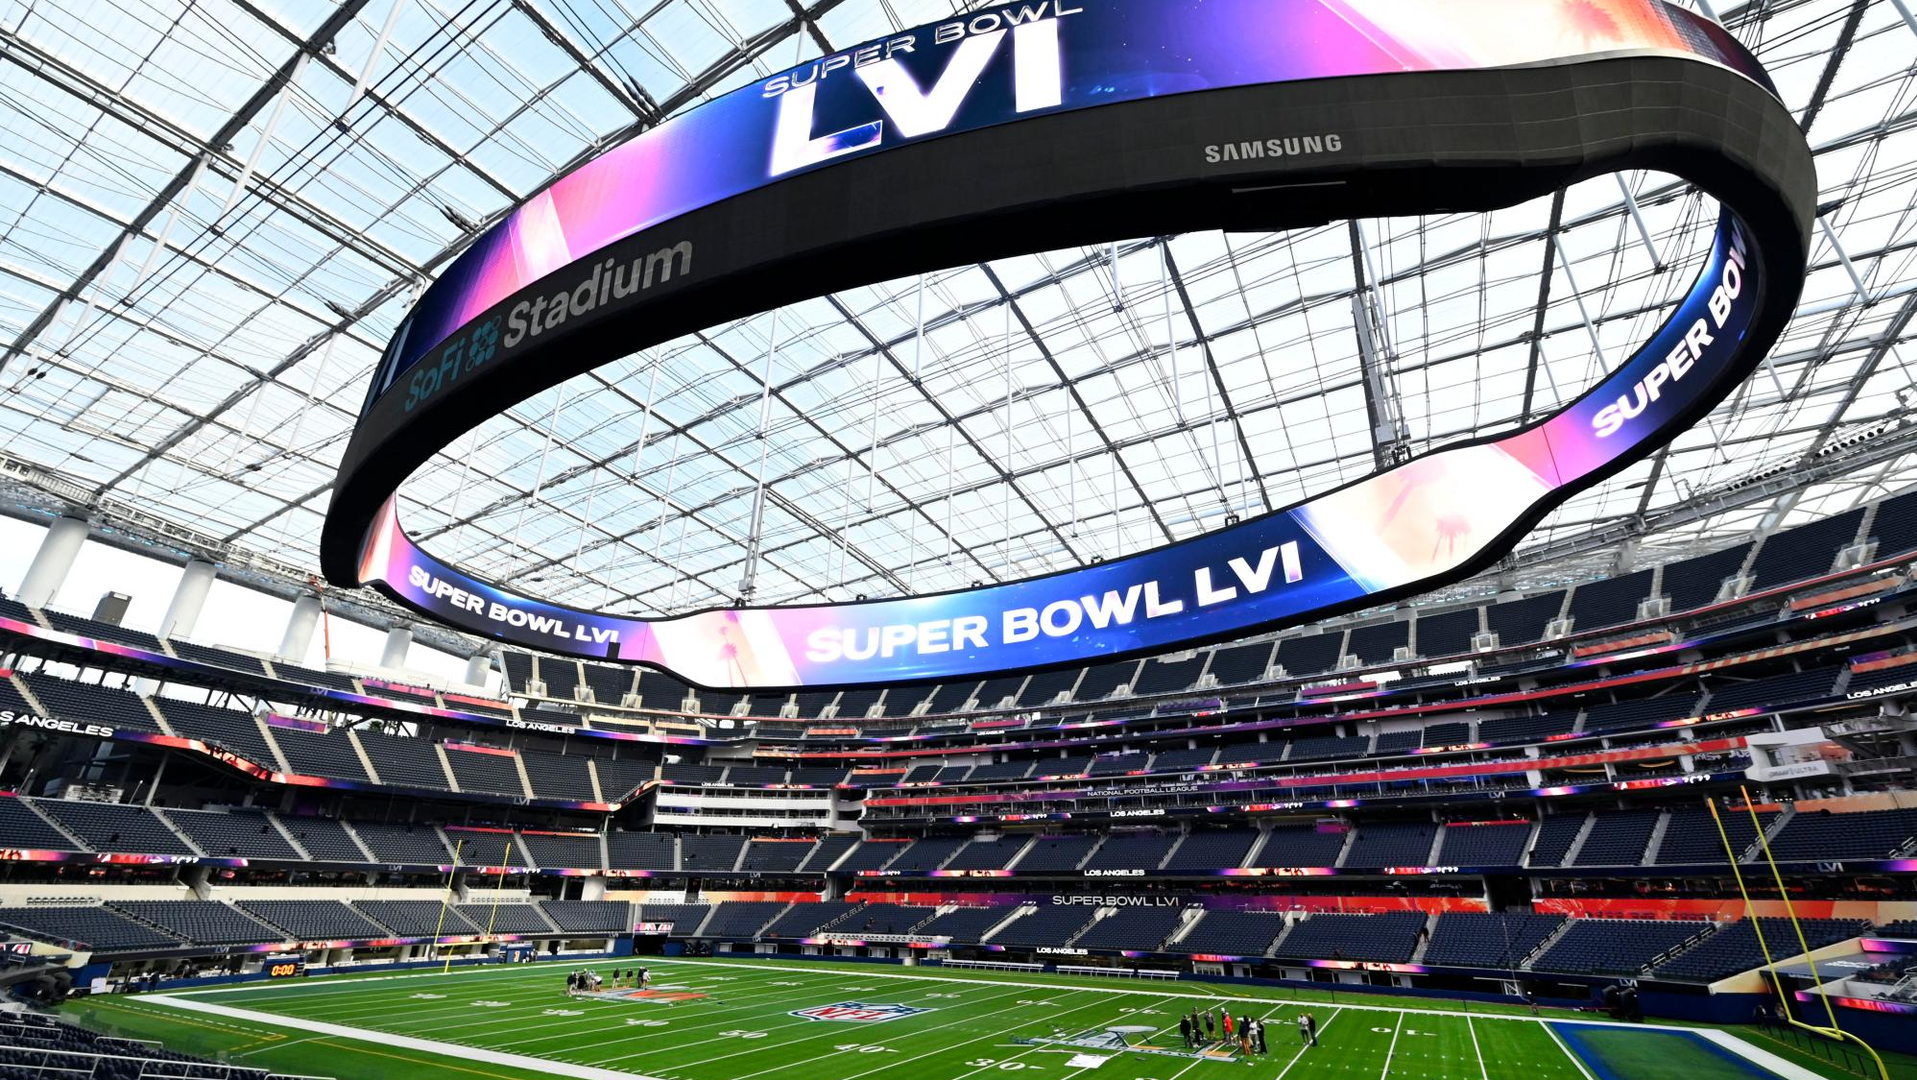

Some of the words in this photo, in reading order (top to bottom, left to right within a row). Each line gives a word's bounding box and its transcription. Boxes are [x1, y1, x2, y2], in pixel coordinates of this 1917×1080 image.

[762, 34, 916, 98] SUPER
[935, 0, 1083, 44] BOWL
[770, 18, 1062, 177] LVI
[1205, 134, 1342, 163] SAMSUNG
[404, 338, 466, 412] SoFi
[504, 241, 692, 348] Stadium
[1592, 318, 1714, 437] SUPER
[408, 565, 485, 615] SUPER
[488, 602, 571, 638] BOWL
[575, 625, 619, 644] LVI
[806, 614, 989, 662] SUPER
[1002, 580, 1183, 645] BOWL
[1193, 540, 1303, 606] LVI
[1847, 690, 1872, 699] LOS
[15, 715, 114, 737] ANGELES
[506, 720, 526, 729] LOS
[527, 722, 576, 734] ANGELES
[1124, 787, 1164, 795] FOOTBALL
[1052, 895, 1104, 906] SUPER
[1105, 896, 1153, 906] BOWL
[1156, 896, 1179, 906] LVI
[271, 964, 295, 976] 0:00
[801, 1007, 884, 1020] NFL
[965, 1058, 1026, 1071] 30
